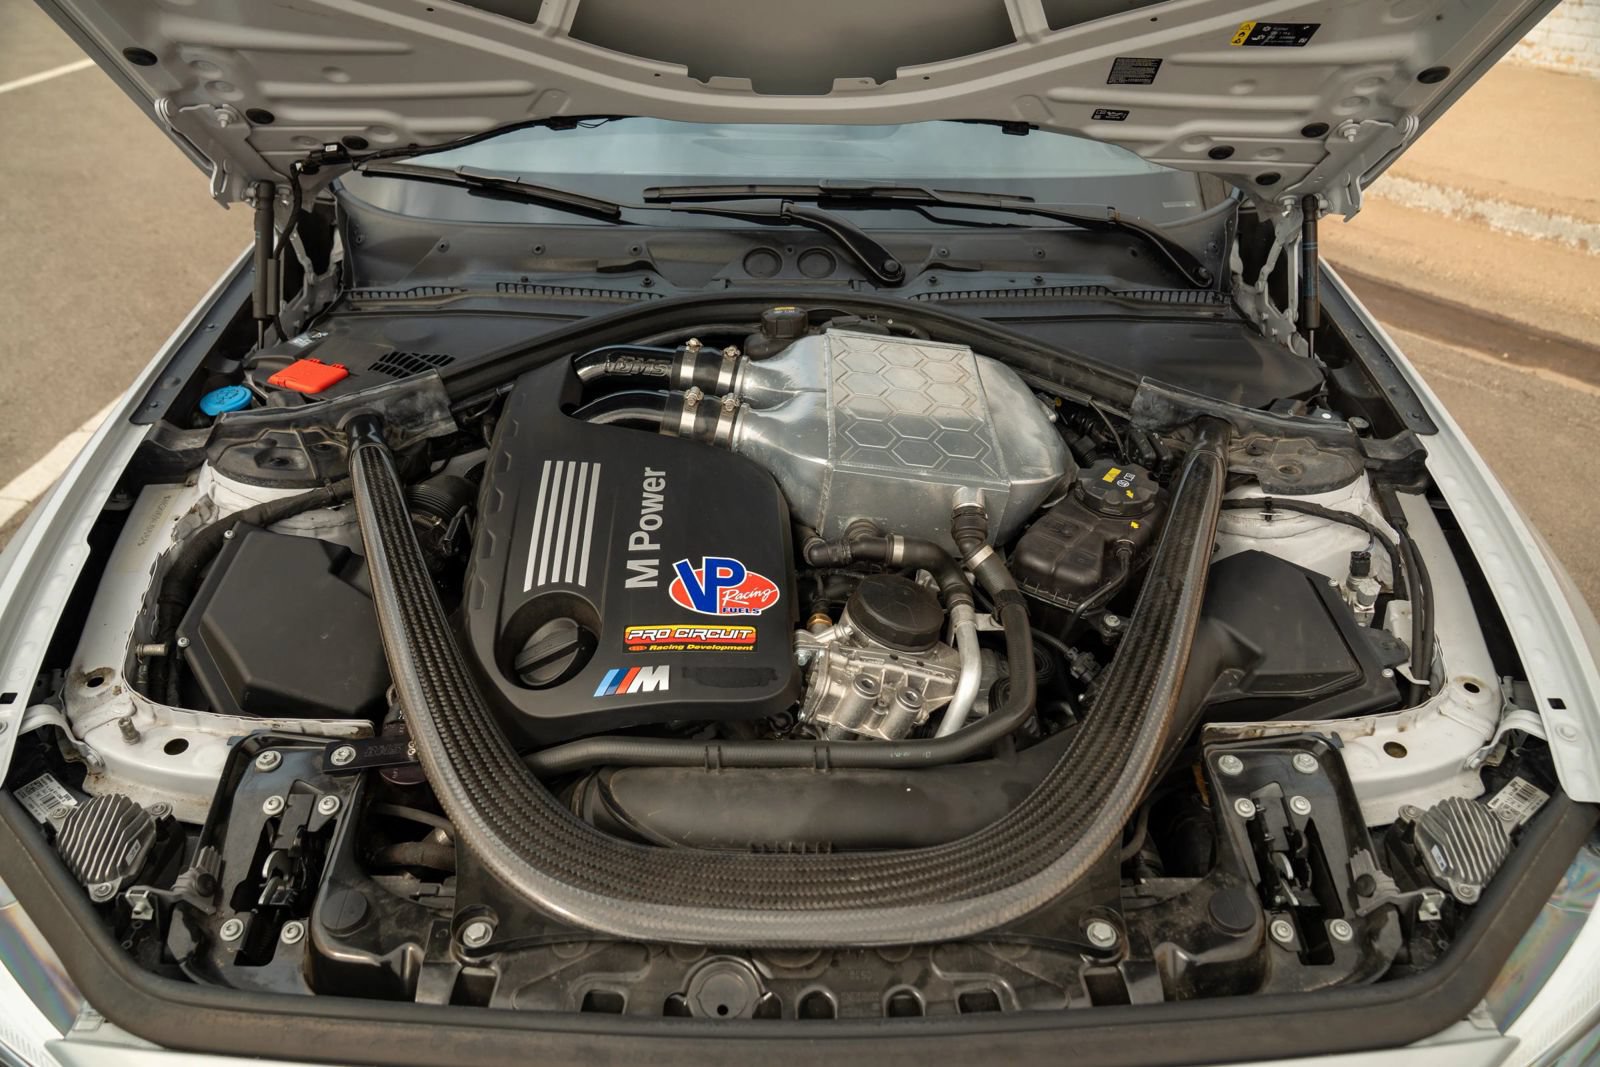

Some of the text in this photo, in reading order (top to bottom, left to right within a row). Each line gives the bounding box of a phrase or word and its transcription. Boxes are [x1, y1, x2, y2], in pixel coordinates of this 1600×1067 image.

[625, 467, 666, 590] M Power
[672, 557, 746, 614] VP
[722, 588, 776, 606] Racing
[628, 629, 752, 640] PRO CIRCUIT
